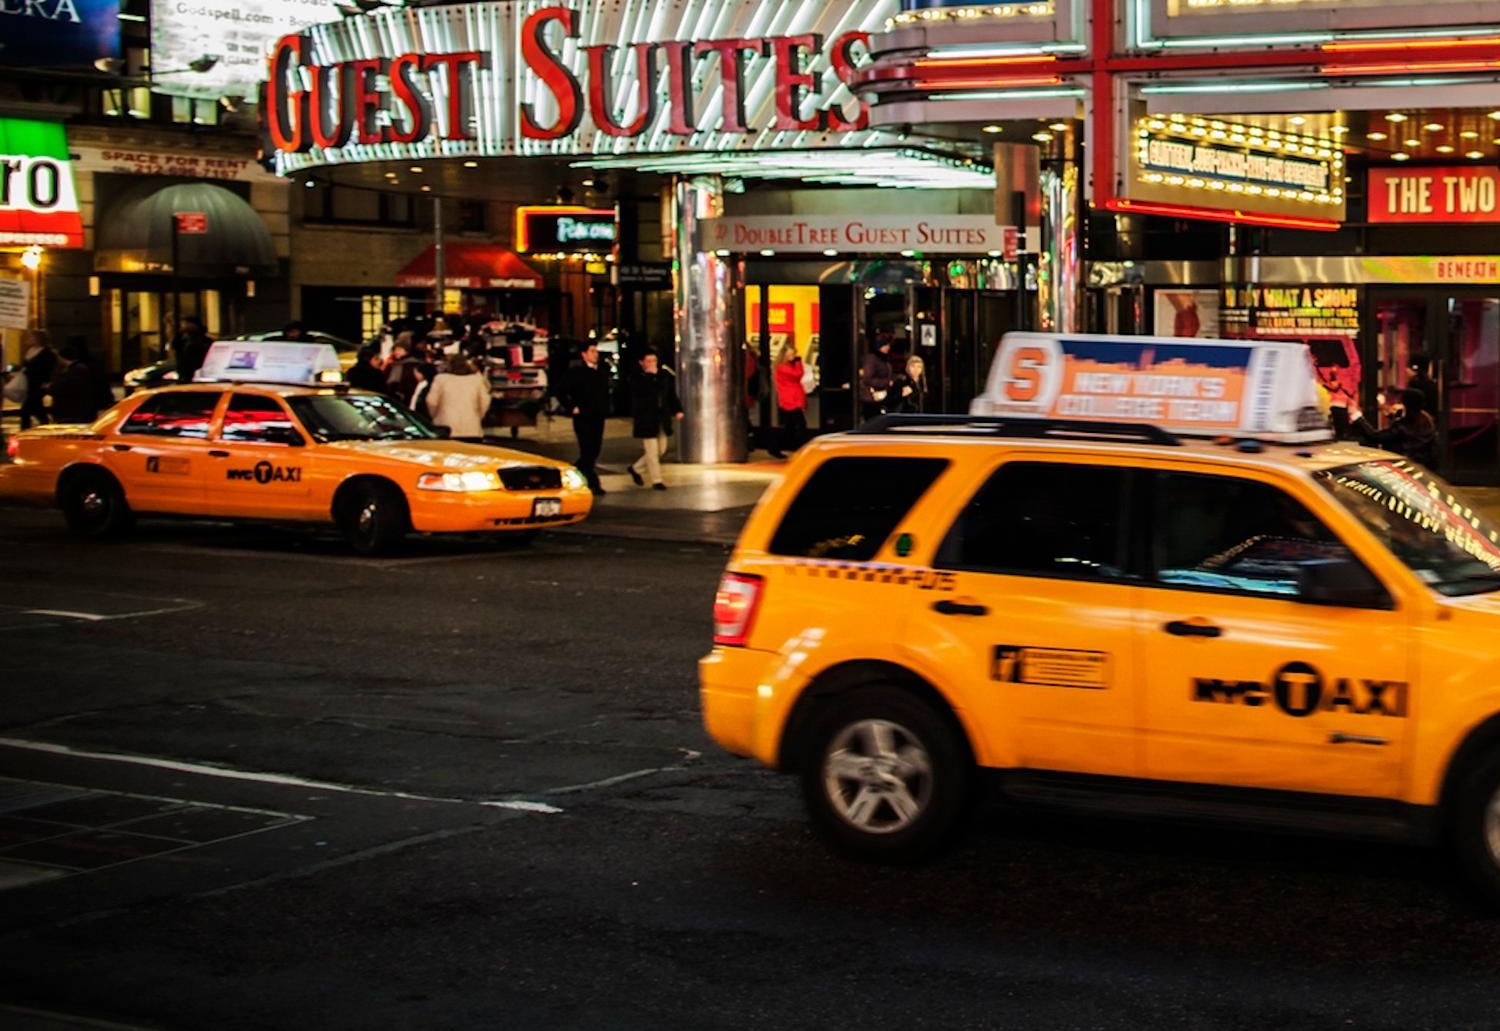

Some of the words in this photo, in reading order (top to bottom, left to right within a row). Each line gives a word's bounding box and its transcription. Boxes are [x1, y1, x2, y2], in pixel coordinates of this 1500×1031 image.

[264, 34, 490, 152] GUEST
[519, 7, 872, 139] SUITES
[101, 150, 159, 164] SPACE
[165, 155, 199, 167] FOR
[206, 157, 249, 169] RENT
[1386, 176, 1431, 215] THE
[1443, 174, 1496, 214] TWO
[845, 221, 911, 245] GUEST
[917, 221, 986, 245] SUITES
[1437, 260, 1497, 278] BENEATH
[1263, 288, 1299, 308] WHAT
[1302, 288, 1312, 308] A
[1074, 371, 1132, 394] NEW
[254, 461, 302, 484] TAXI
[1191, 676, 1268, 706] NYC
[1272, 661, 1409, 719] TAXI
